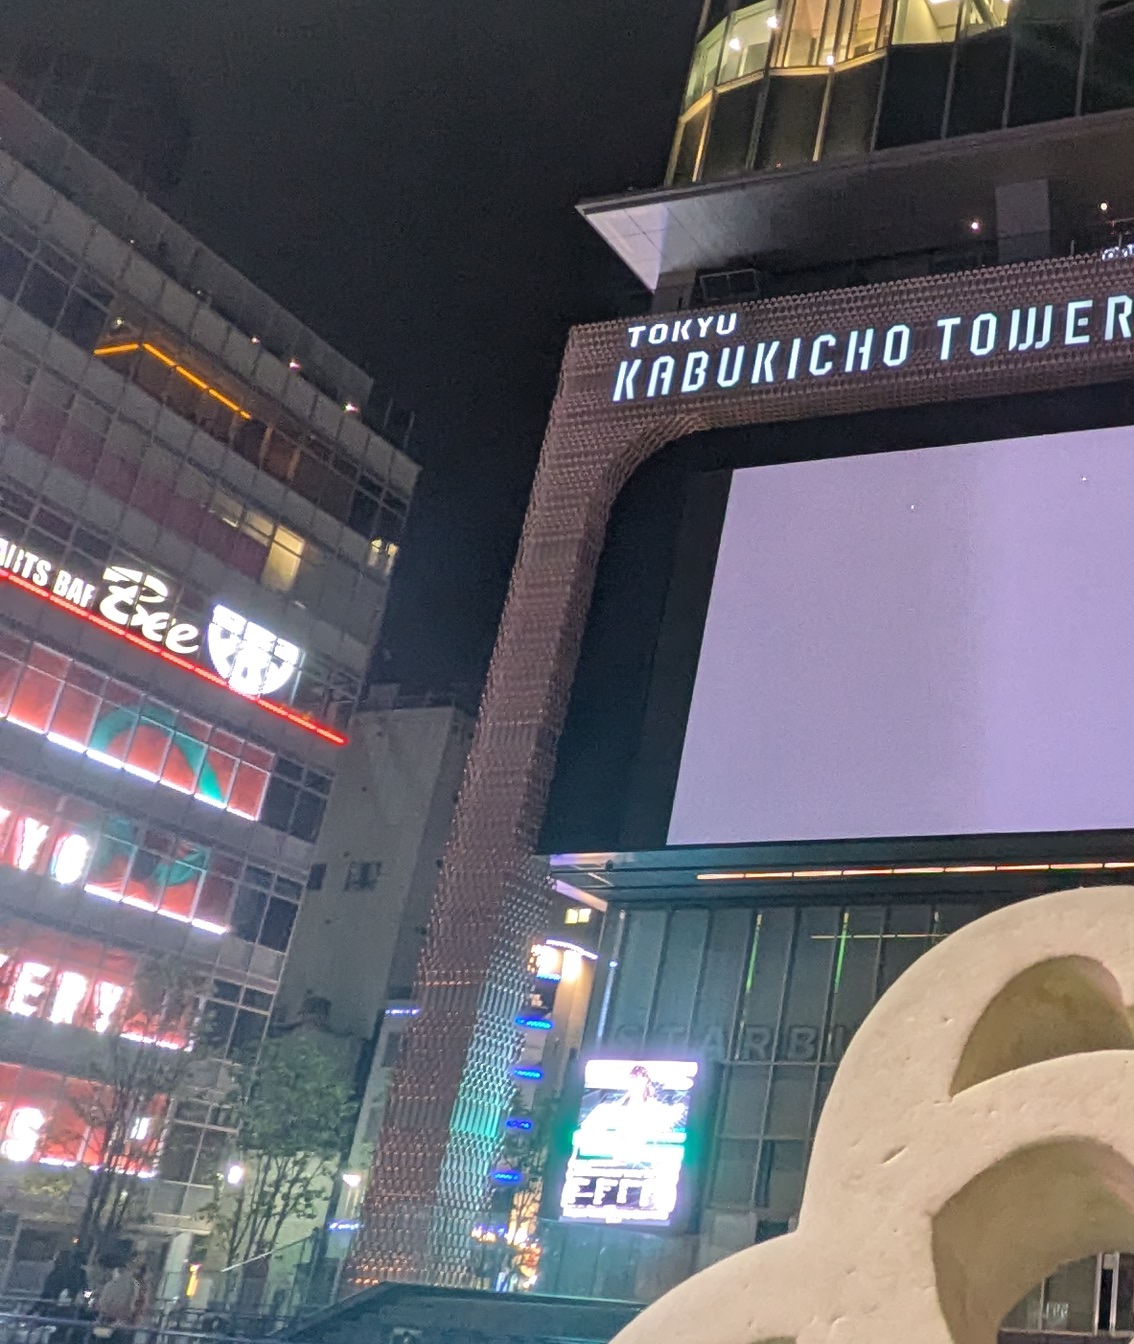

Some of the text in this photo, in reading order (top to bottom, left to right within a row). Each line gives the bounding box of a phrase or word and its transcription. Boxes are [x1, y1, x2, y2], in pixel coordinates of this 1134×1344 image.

[612, 294, 1134, 402] KABUKICHO TOWER
[627, 312, 738, 348] TOKYU
